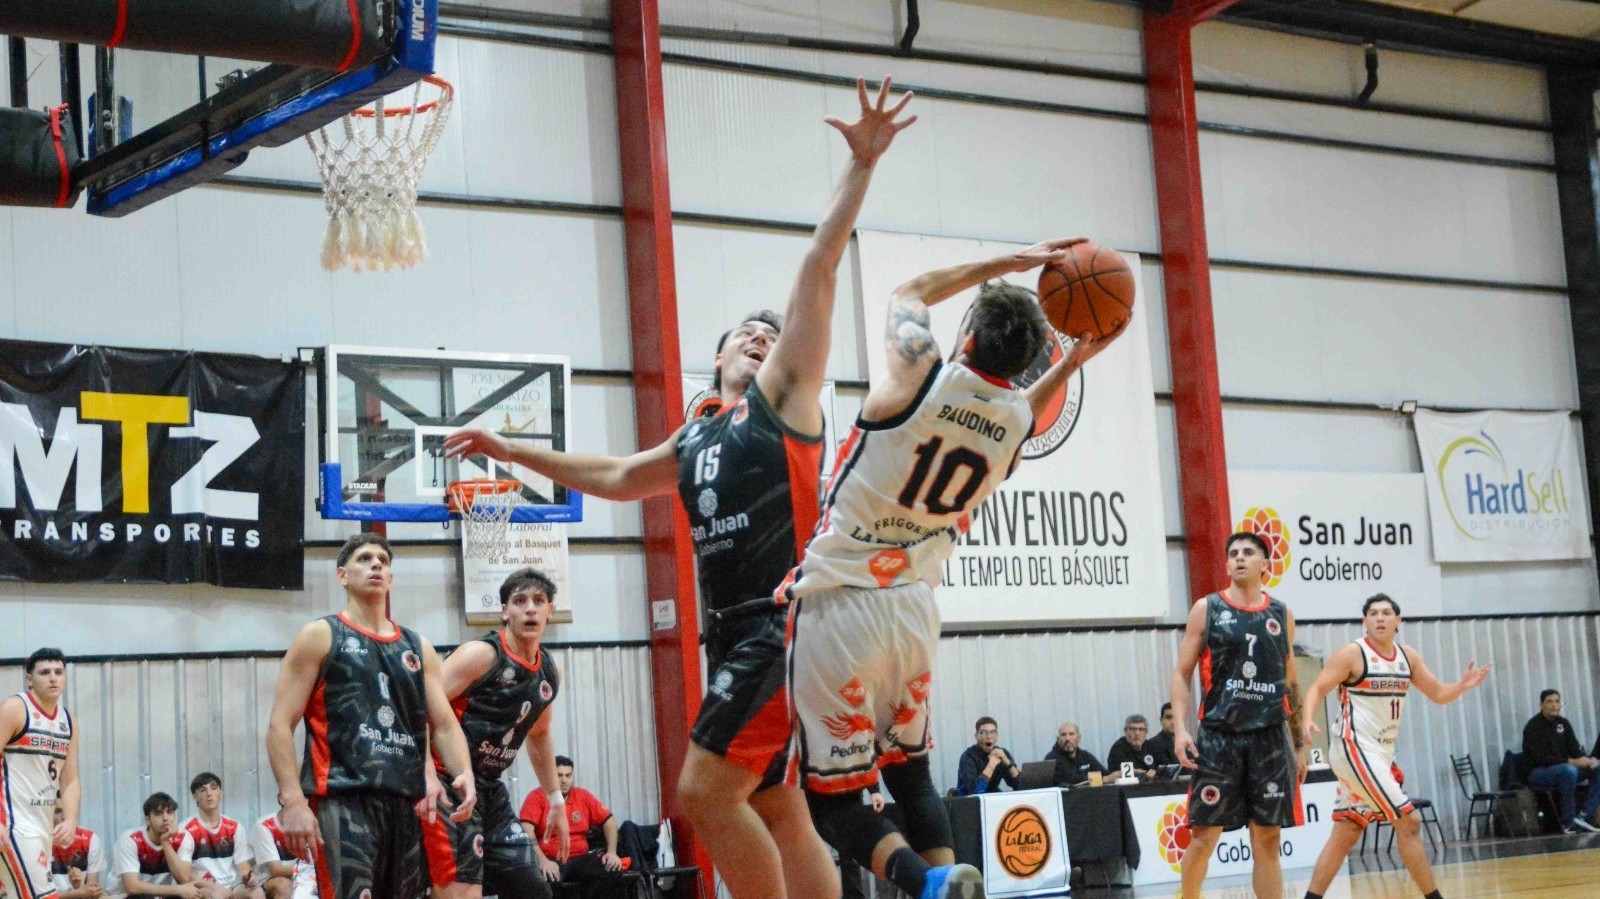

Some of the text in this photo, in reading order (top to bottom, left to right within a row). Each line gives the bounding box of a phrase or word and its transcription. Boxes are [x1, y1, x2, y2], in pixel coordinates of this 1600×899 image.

[936, 403, 1007, 443] BAUDINO
[1025, 400, 1077, 453] Argentina
[0, 390, 261, 521] MTZ
[694, 443, 722, 485] 15
[896, 434, 993, 516] 10
[1464, 468, 1569, 515] HardSell
[0, 519, 261, 548] RANSPORTES
[708, 512, 750, 537] Juan
[1298, 515, 1413, 546] San Juan
[502, 555, 519, 565] San
[521, 555, 543, 565] Juan
[959, 555, 1023, 587] TEMPLO
[1028, 555, 1058, 586] DEL
[1061, 548, 1130, 588] BÁSQUET
[1299, 556, 1383, 582] Gobierno
[1245, 632, 1257, 657] 7
[1226, 678, 1276, 693] San Juan
[1232, 690, 1264, 701] Gobierno
[1390, 698, 1400, 720] 11
[360, 723, 415, 747] San Juan
[371, 741, 404, 757] Gobierno
[479, 740, 501, 756] San
[1314, 750, 1322, 764] 2
[48, 760, 58, 781] 6
[1123, 763, 1132, 778] 2
